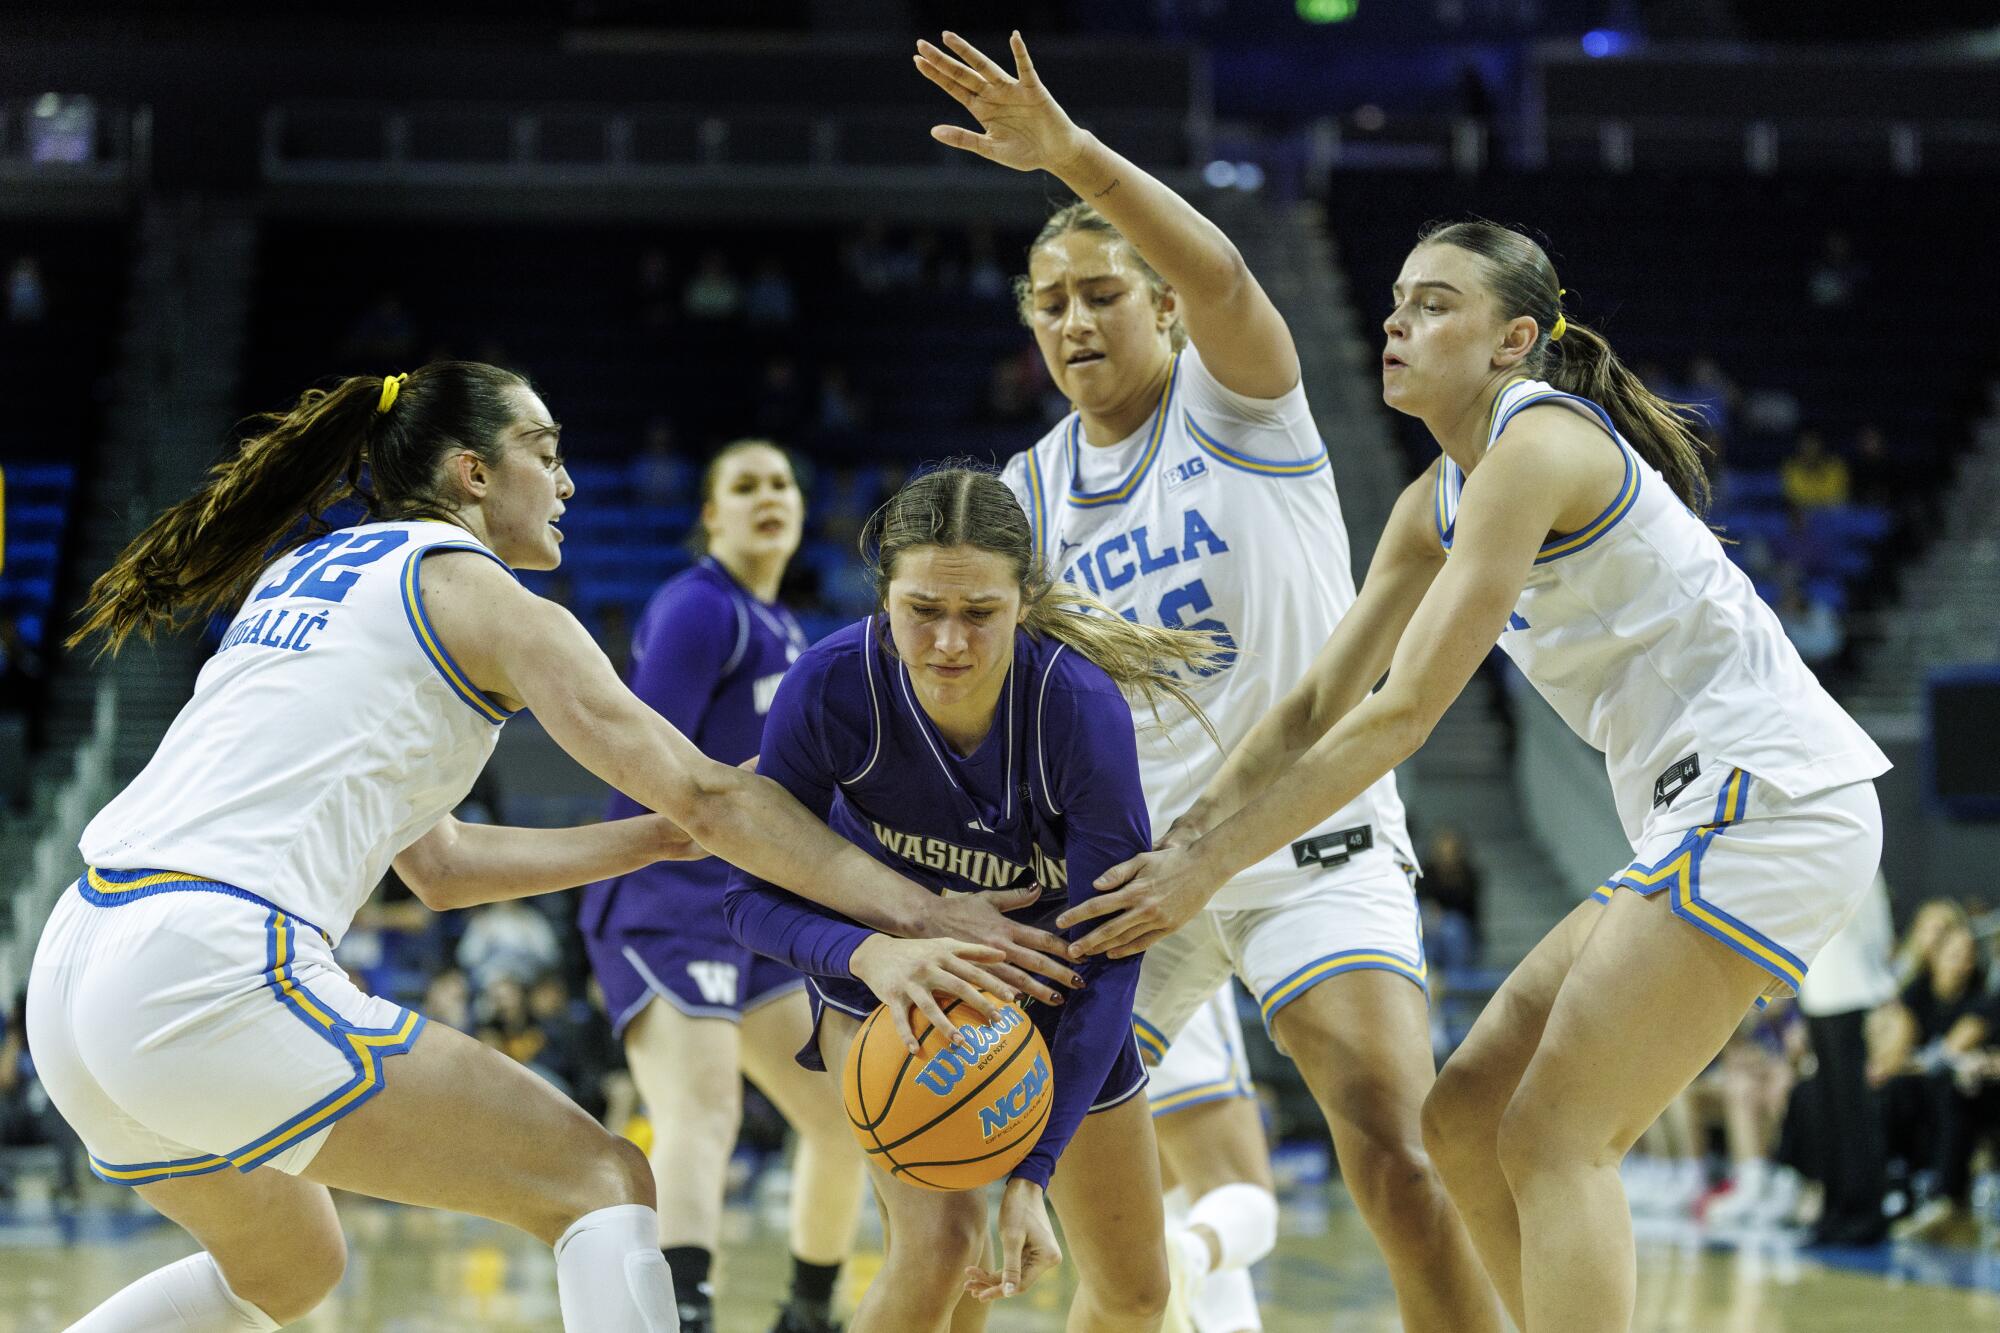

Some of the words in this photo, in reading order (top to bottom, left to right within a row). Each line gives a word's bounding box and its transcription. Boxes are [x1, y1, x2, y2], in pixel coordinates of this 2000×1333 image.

[253, 530, 409, 603] 32
[1350, 833, 1363, 846] 48
[687, 960, 739, 1005] W
[914, 1004, 1024, 1098] Wilson
[978, 1055, 994, 1071] EVO
[993, 1039, 1009, 1055] NXT
[978, 1052, 1049, 1139] NCAA
